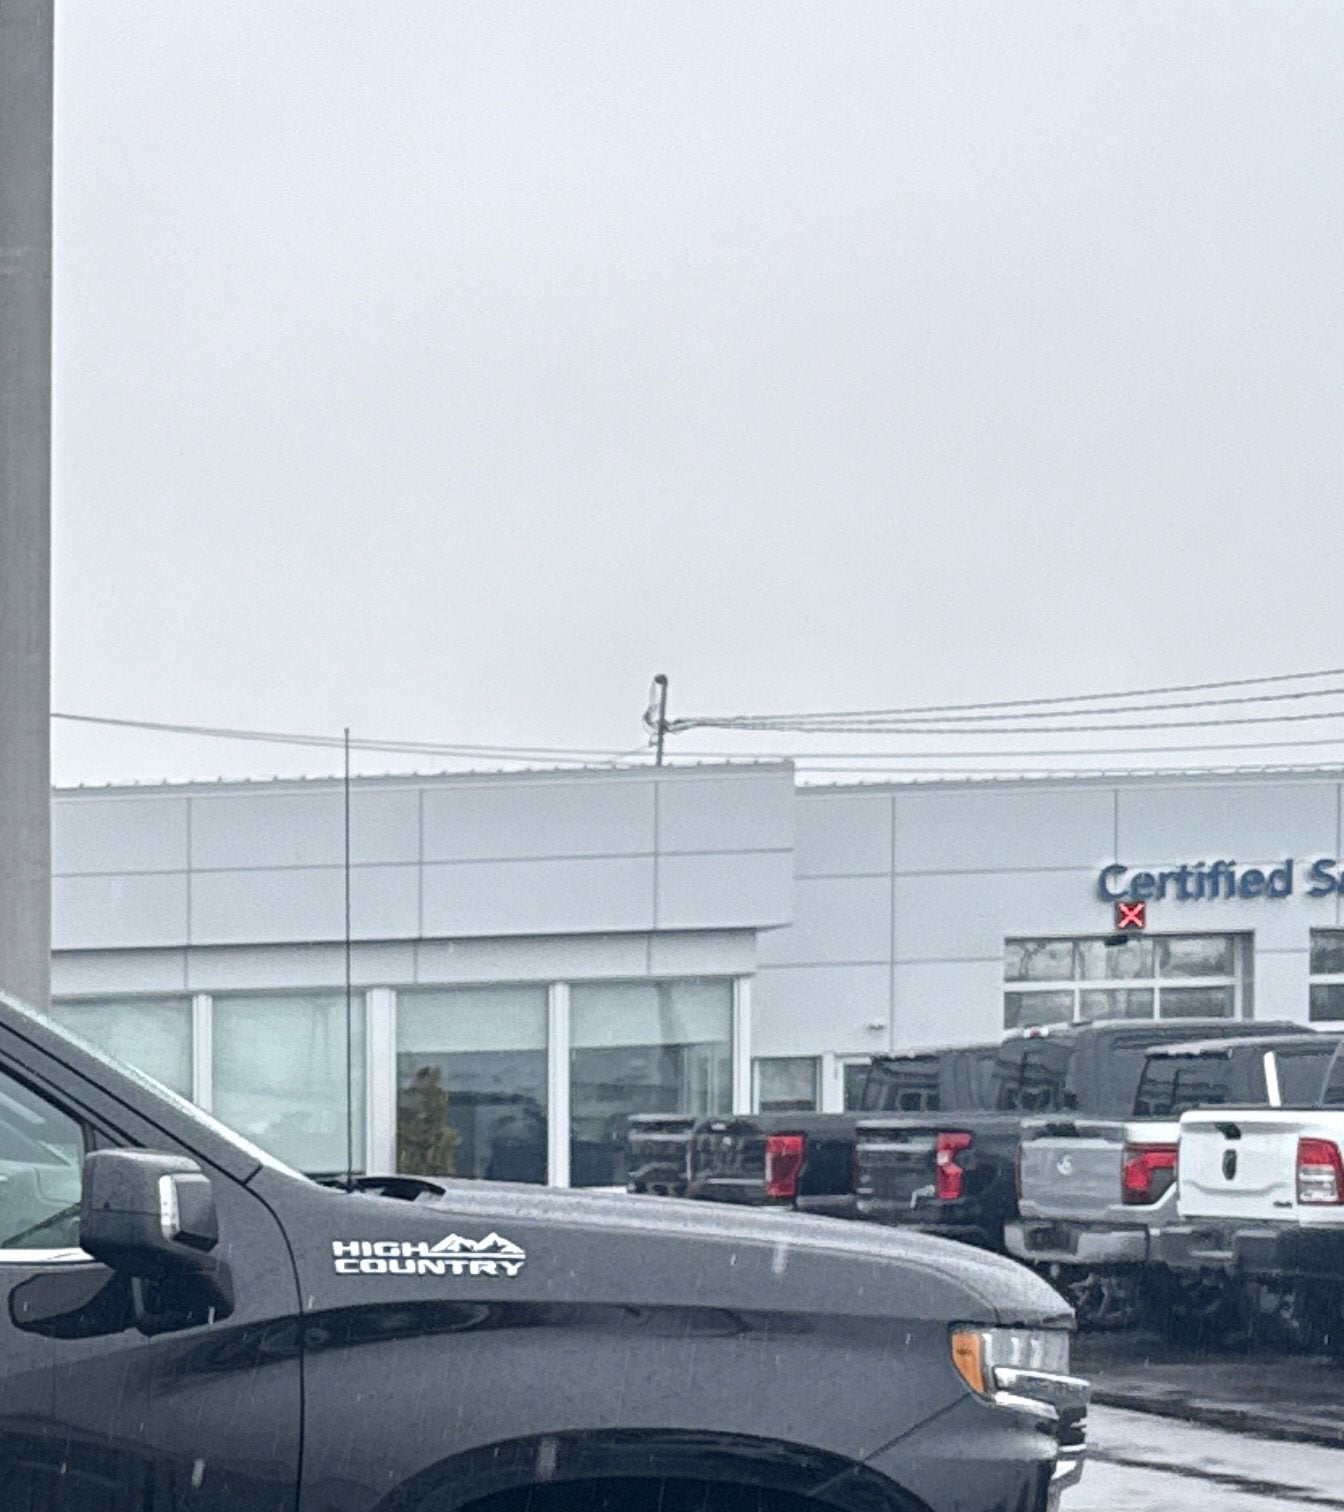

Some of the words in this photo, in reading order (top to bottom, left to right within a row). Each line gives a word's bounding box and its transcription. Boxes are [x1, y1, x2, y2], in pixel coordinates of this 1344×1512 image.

[1099, 859, 1293, 899] Certified
[1308, 859, 1344, 897] S
[332, 1241, 429, 1256] HIGH
[335, 1259, 525, 1276] COUNTRY
